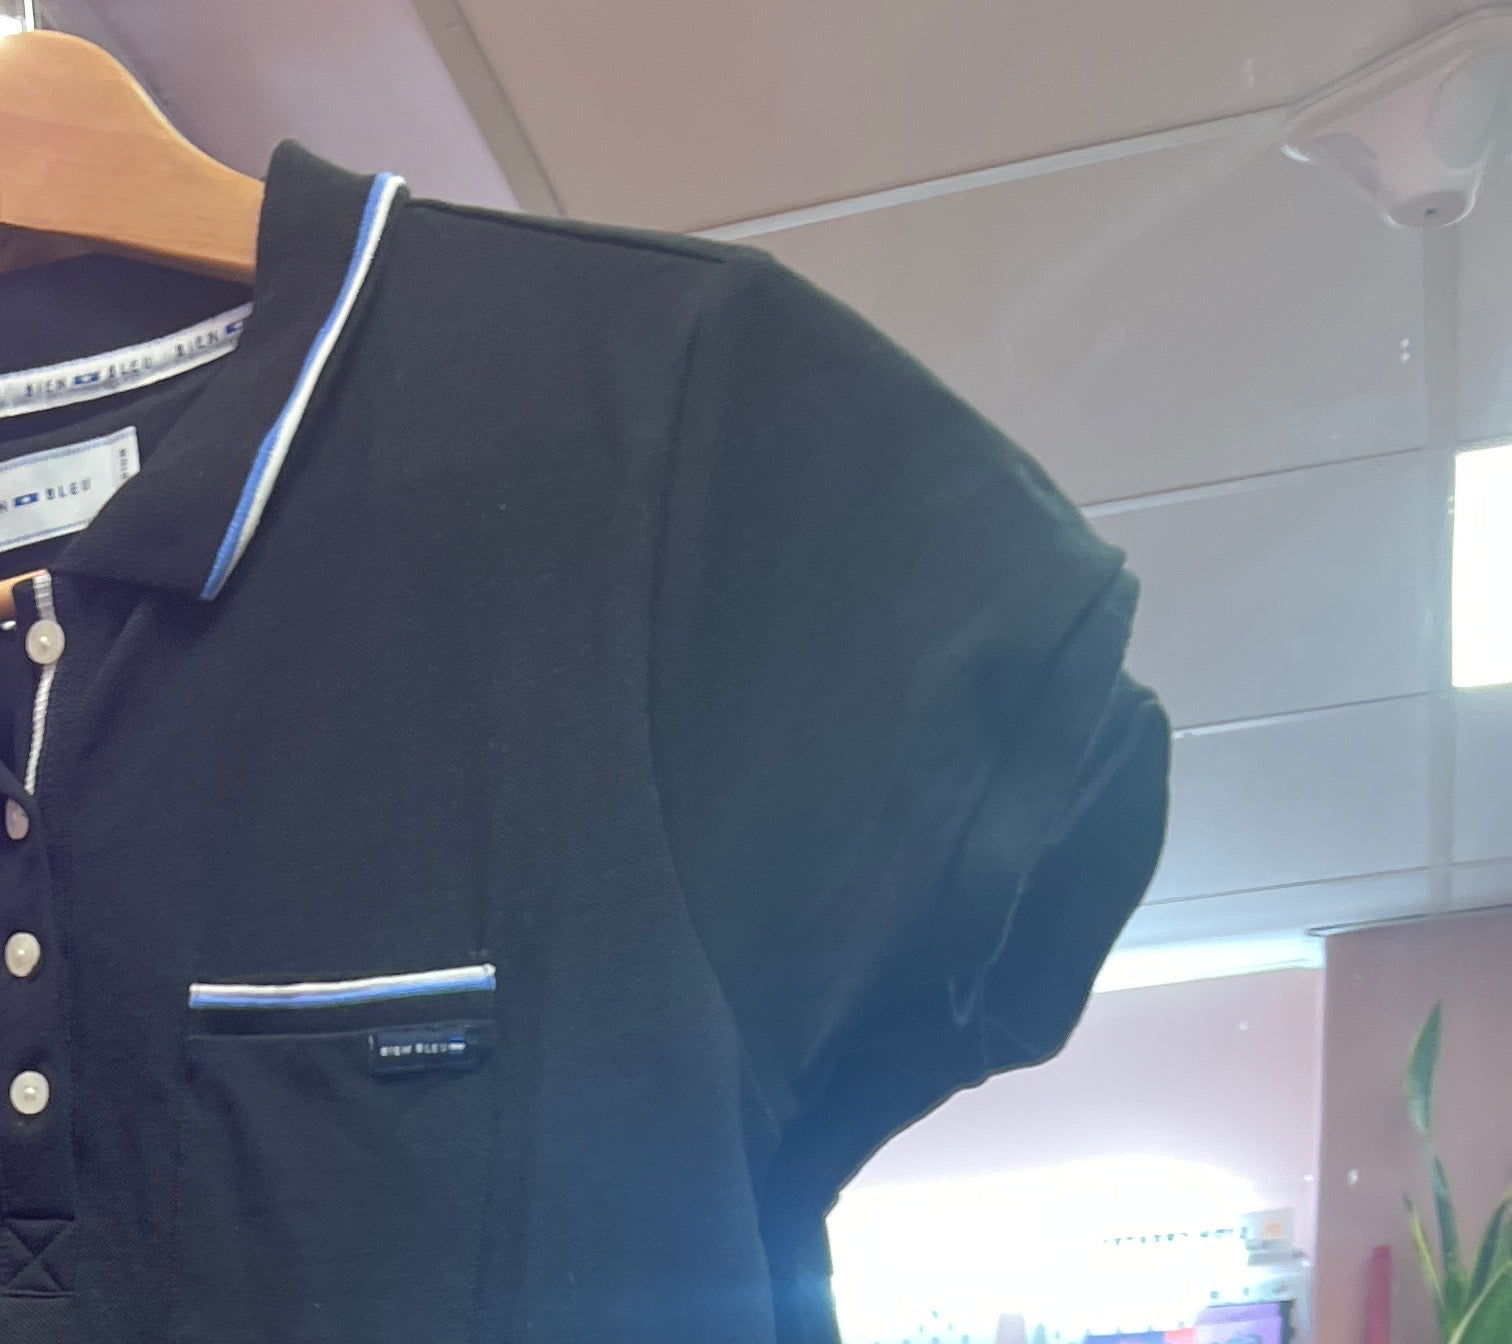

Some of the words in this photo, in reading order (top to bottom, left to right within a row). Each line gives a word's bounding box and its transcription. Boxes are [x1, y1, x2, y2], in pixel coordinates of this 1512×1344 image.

[44, 477, 92, 502] BLEU
[379, 1045, 413, 1057] BIEN
[415, 1042, 448, 1055] BLEU
